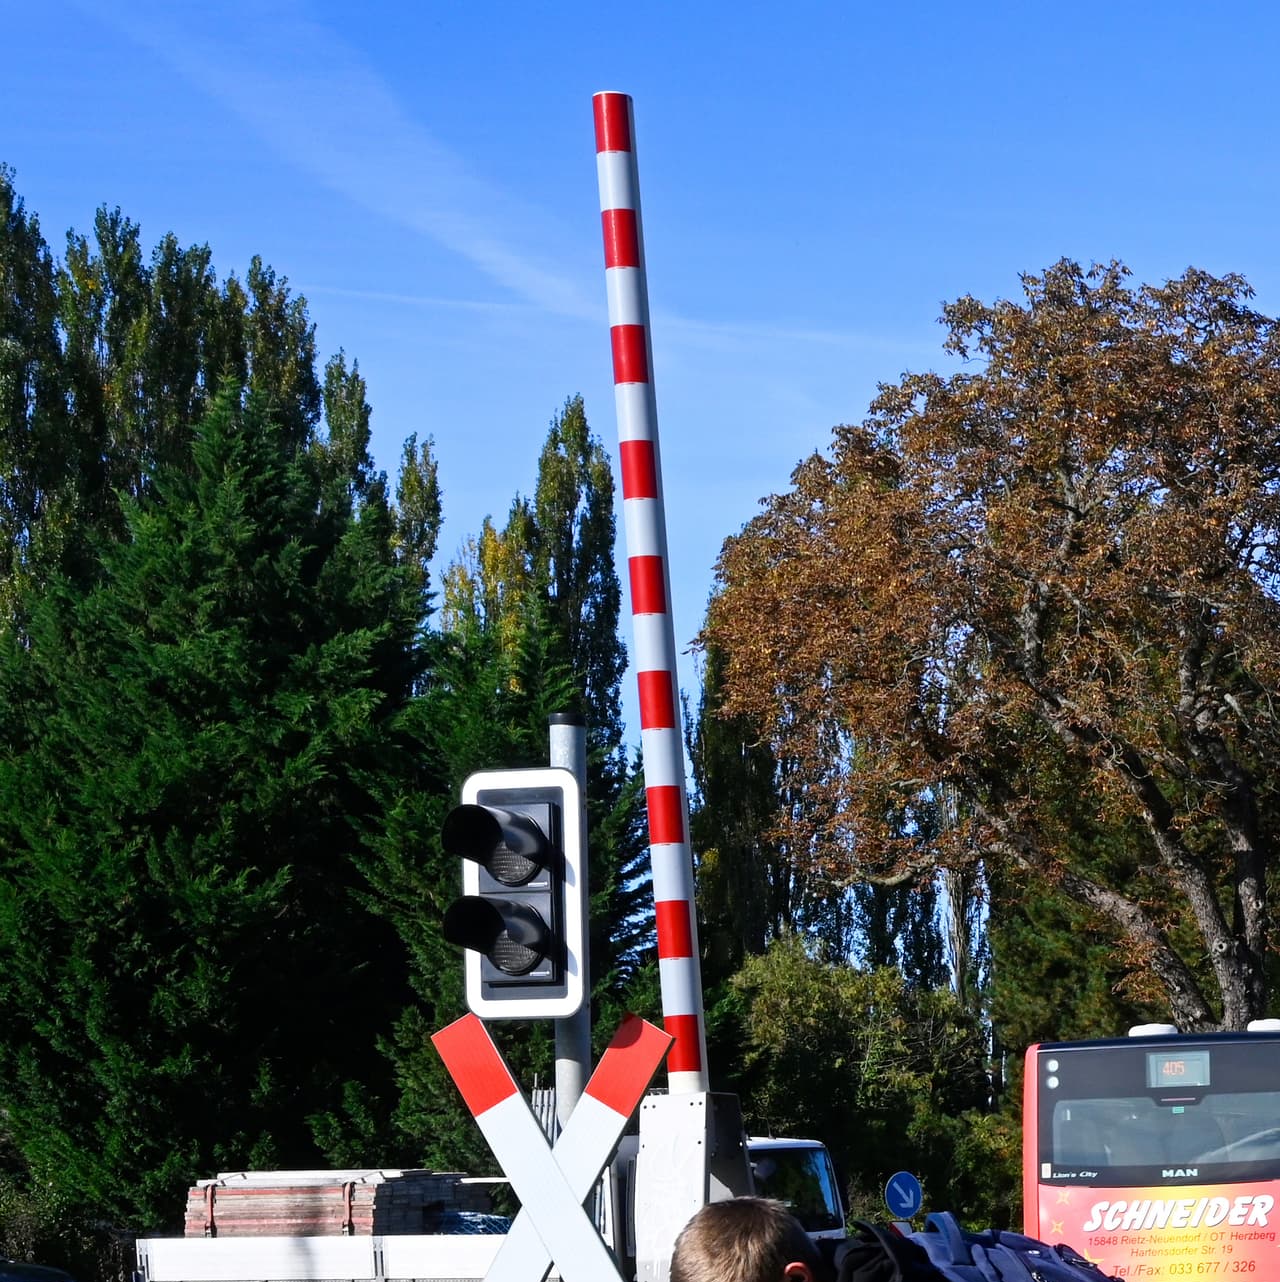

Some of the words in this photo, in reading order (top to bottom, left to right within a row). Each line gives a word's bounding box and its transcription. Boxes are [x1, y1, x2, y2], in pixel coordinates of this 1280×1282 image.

[1079, 1170, 1098, 1179] City
[1161, 1168, 1198, 1178] MAN
[1083, 1195, 1275, 1232] SCHNEIDER
[1088, 1234, 1118, 1247] 15848
[1120, 1232, 1201, 1246] Rietz-Neuendorf
[1210, 1230, 1226, 1242] OT
[1230, 1229, 1276, 1243] Herzberg
[1130, 1246, 1199, 1258] Hartensdorfer
[1201, 1244, 1217, 1256] Str.
[1222, 1244, 1233, 1255] 19
[1112, 1264, 1166, 1277] Tel./Fax:
[1168, 1262, 1193, 1275] 033
[1196, 1261, 1221, 1274] 677
[1232, 1260, 1256, 1273] 326
